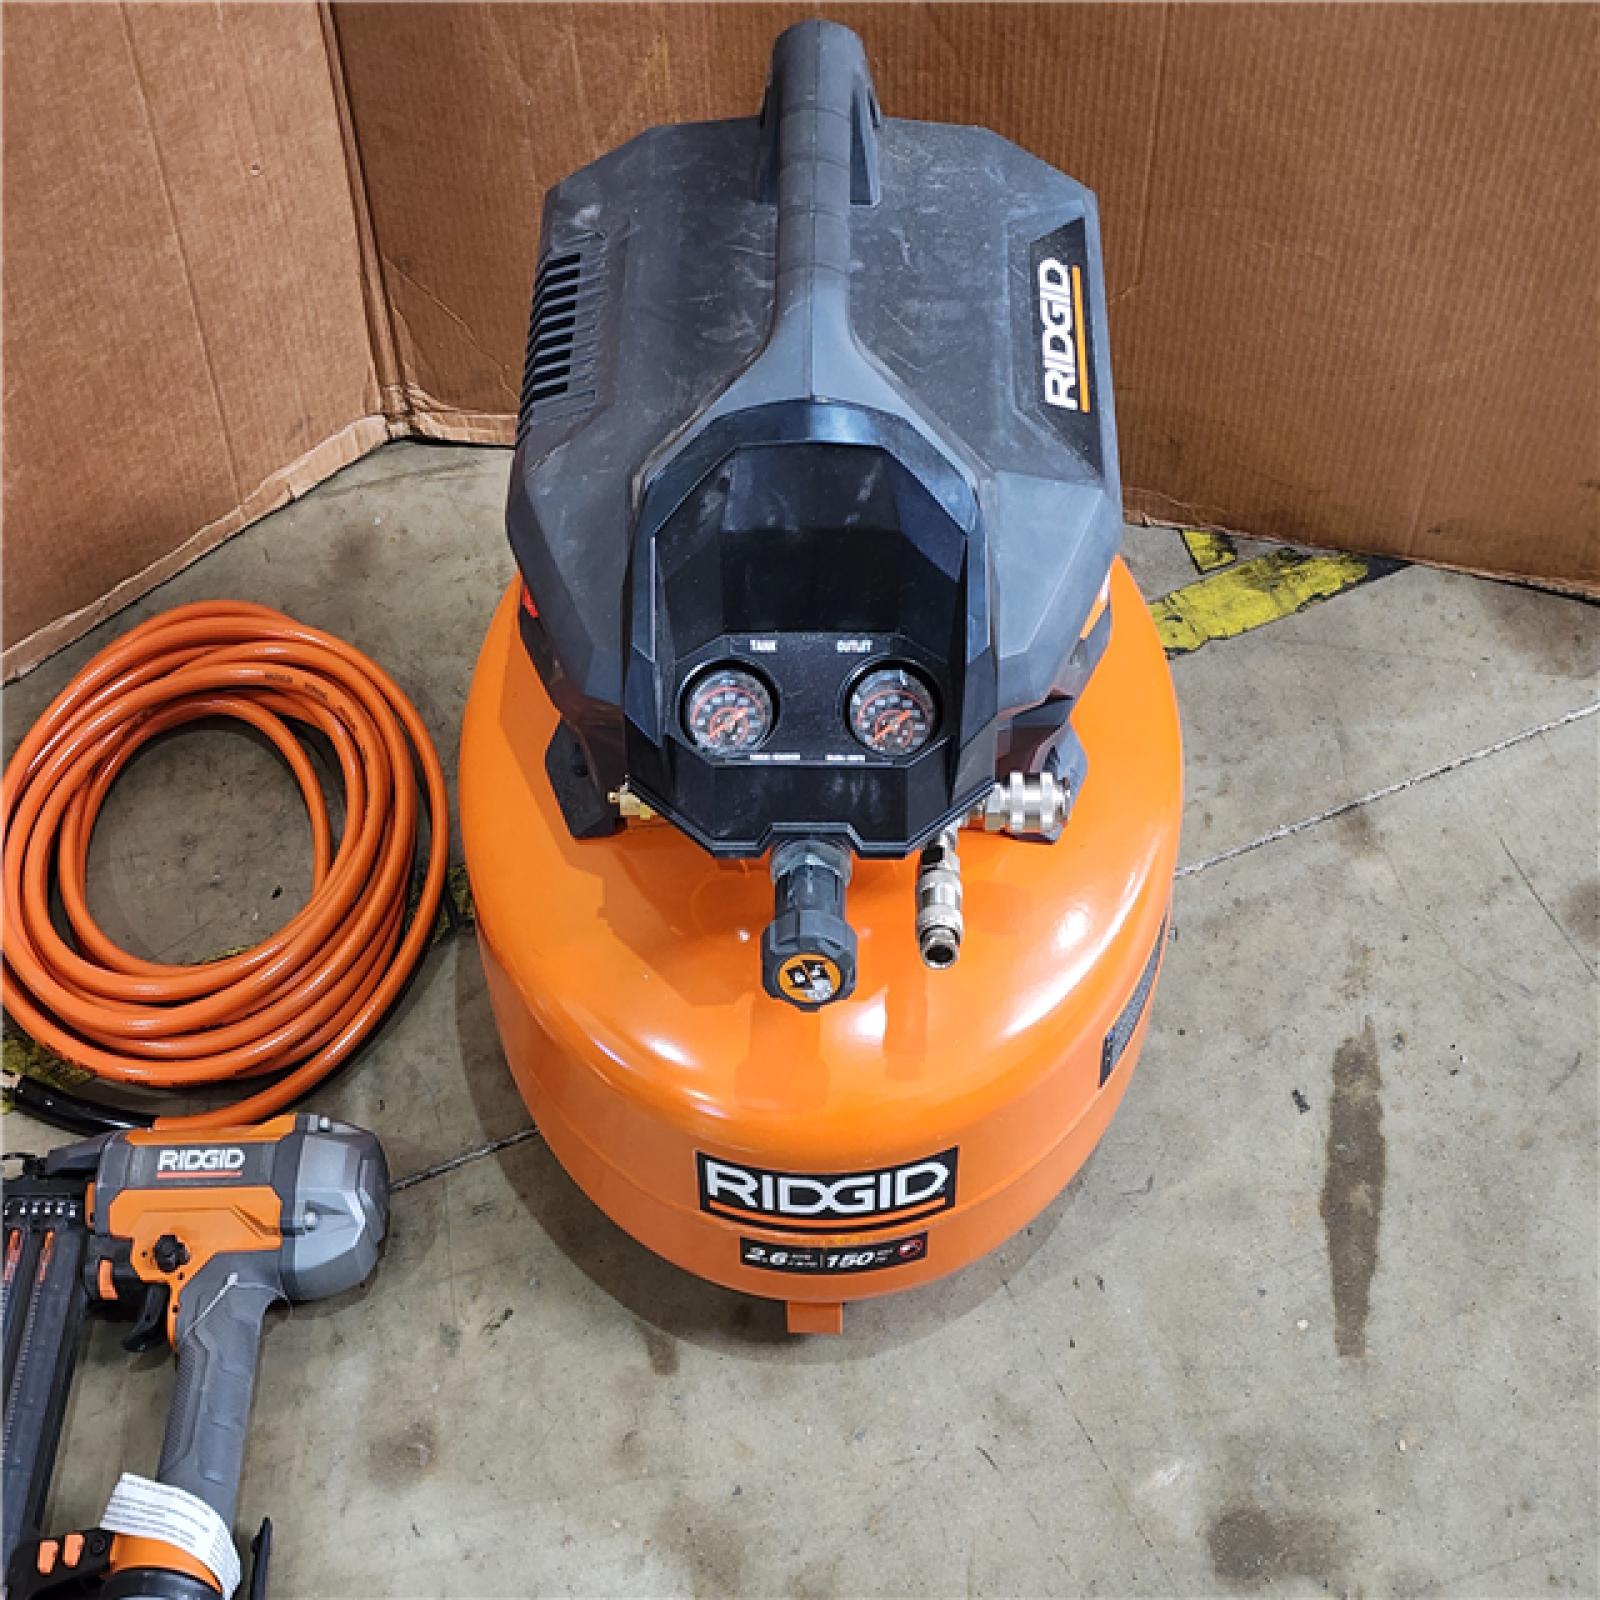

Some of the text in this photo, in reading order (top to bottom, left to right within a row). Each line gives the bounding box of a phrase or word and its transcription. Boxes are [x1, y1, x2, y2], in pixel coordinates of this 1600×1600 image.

[1039, 257, 1078, 410] RIDGID
[157, 1148, 246, 1171] RIDGID
[705, 1160, 950, 1214] RIDGID
